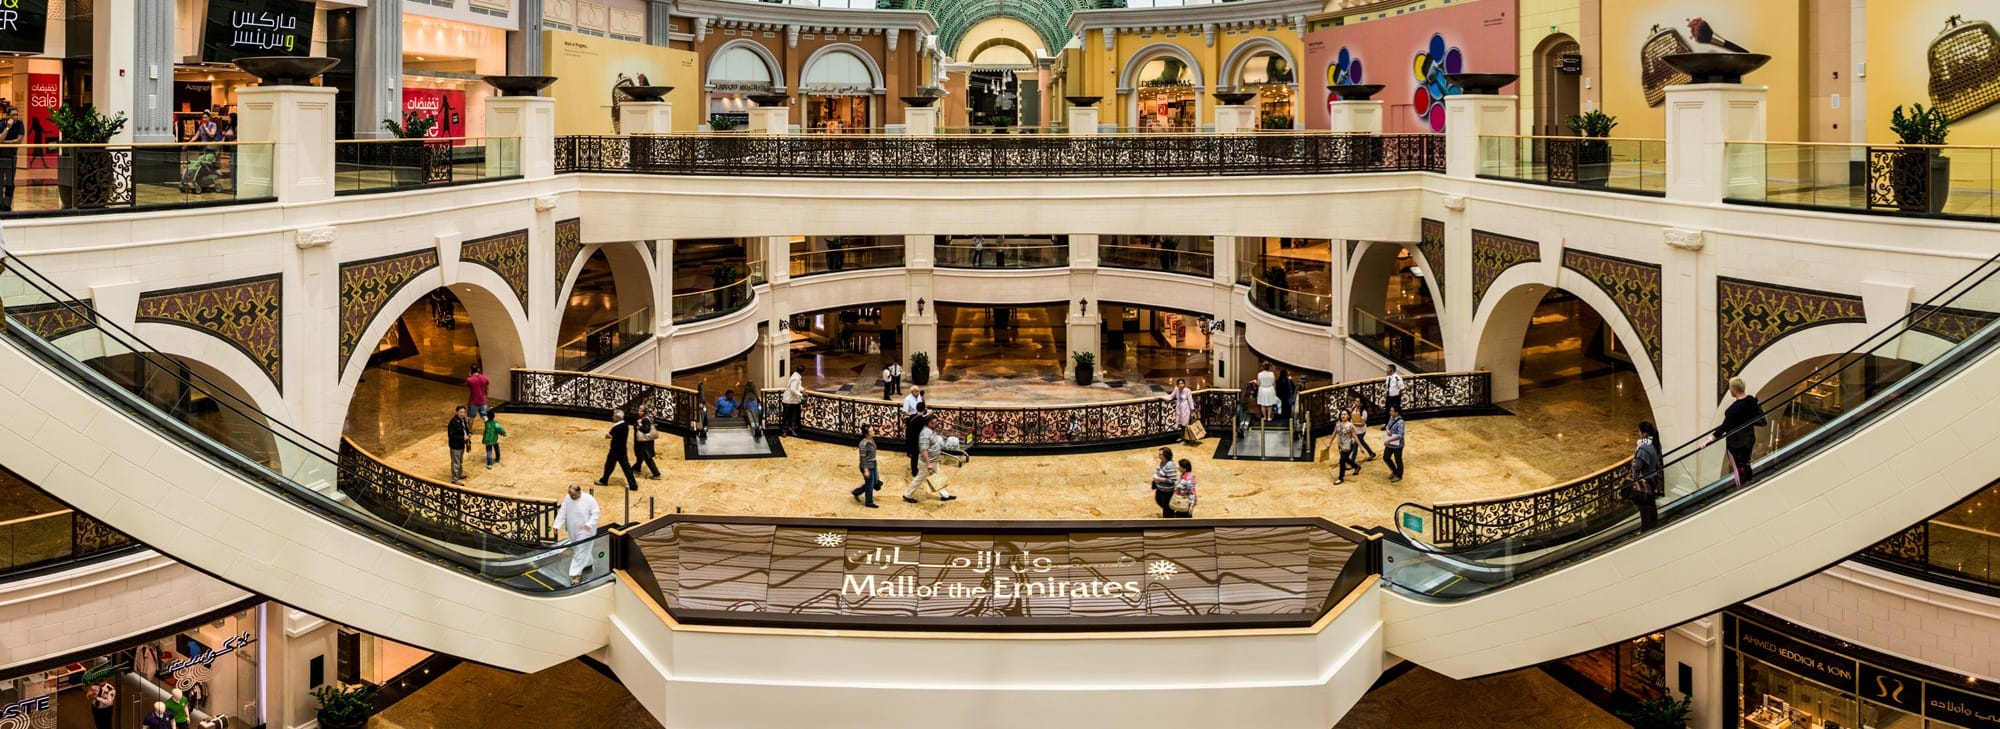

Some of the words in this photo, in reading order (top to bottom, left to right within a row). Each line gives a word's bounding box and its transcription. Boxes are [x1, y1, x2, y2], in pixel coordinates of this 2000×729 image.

[232, 10, 296, 31] ماركس
[1141, 79, 1193, 88] DEBENHAMS
[31, 93, 57, 108] sale
[407, 97, 439, 114] تخفيضات
[841, 574, 917, 598] Mall
[917, 582, 943, 598] of
[948, 582, 988, 600] the
[993, 577, 1141, 599] Emirates
[1743, 634, 1777, 653] AHMED
[1816, 661, 1825, 672] &
[1827, 664, 1852, 681] SONS
